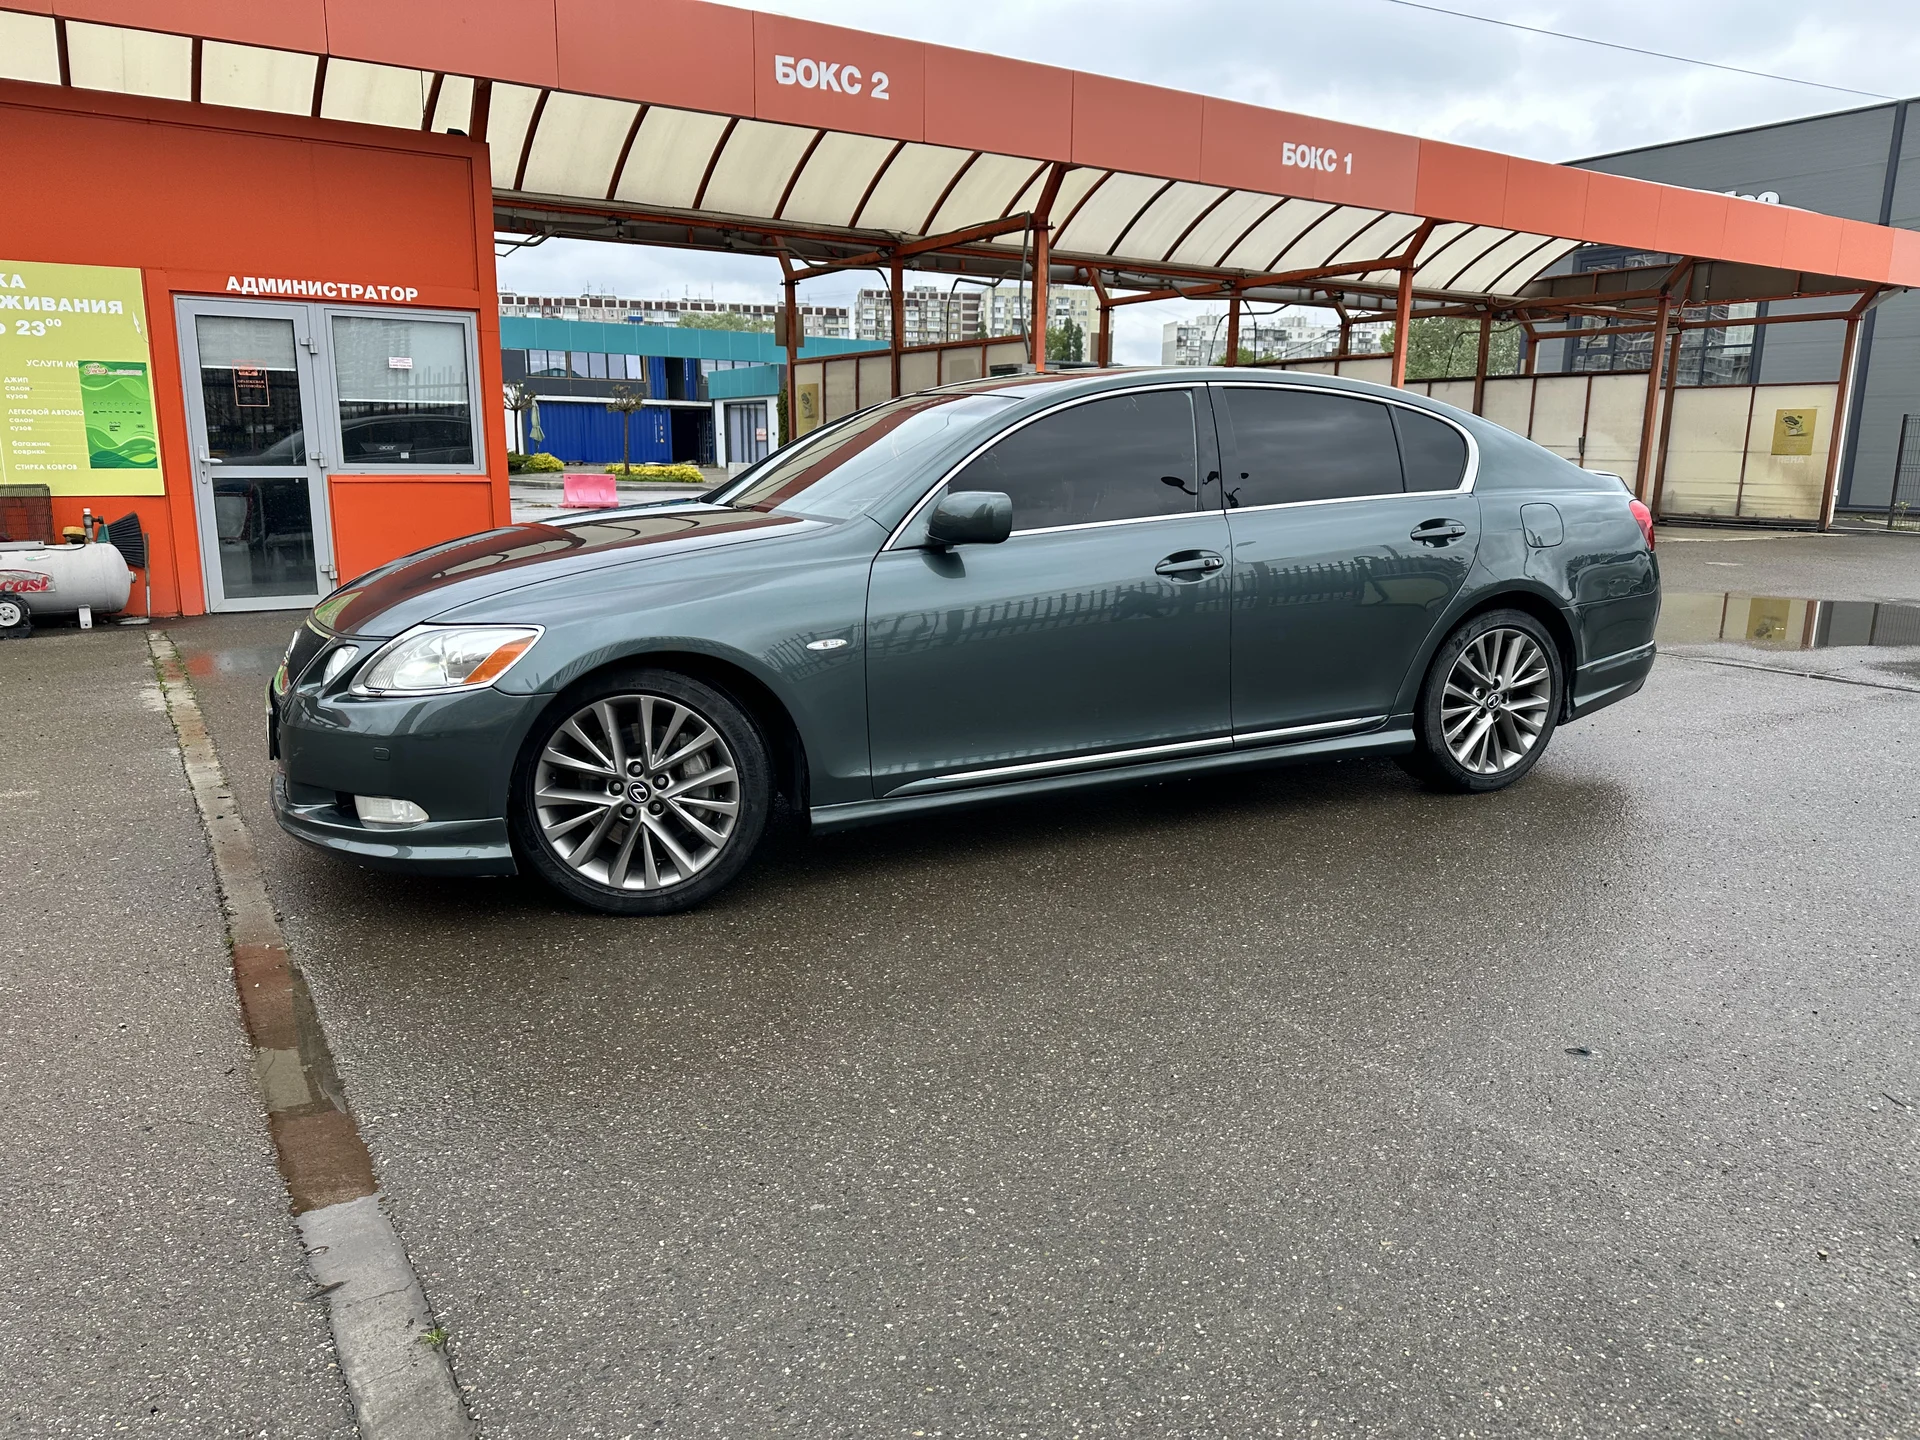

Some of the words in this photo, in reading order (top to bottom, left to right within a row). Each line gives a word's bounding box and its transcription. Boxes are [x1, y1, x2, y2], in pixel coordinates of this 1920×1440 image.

[775, 55, 862, 94] БОКС
[871, 71, 889, 100] 2
[1282, 142, 1337, 172] БОКС
[1344, 153, 1353, 174] 1
[226, 276, 418, 301] АДМИНИСТРАТОР
[26, 359, 63, 368] УСЛУГИ
